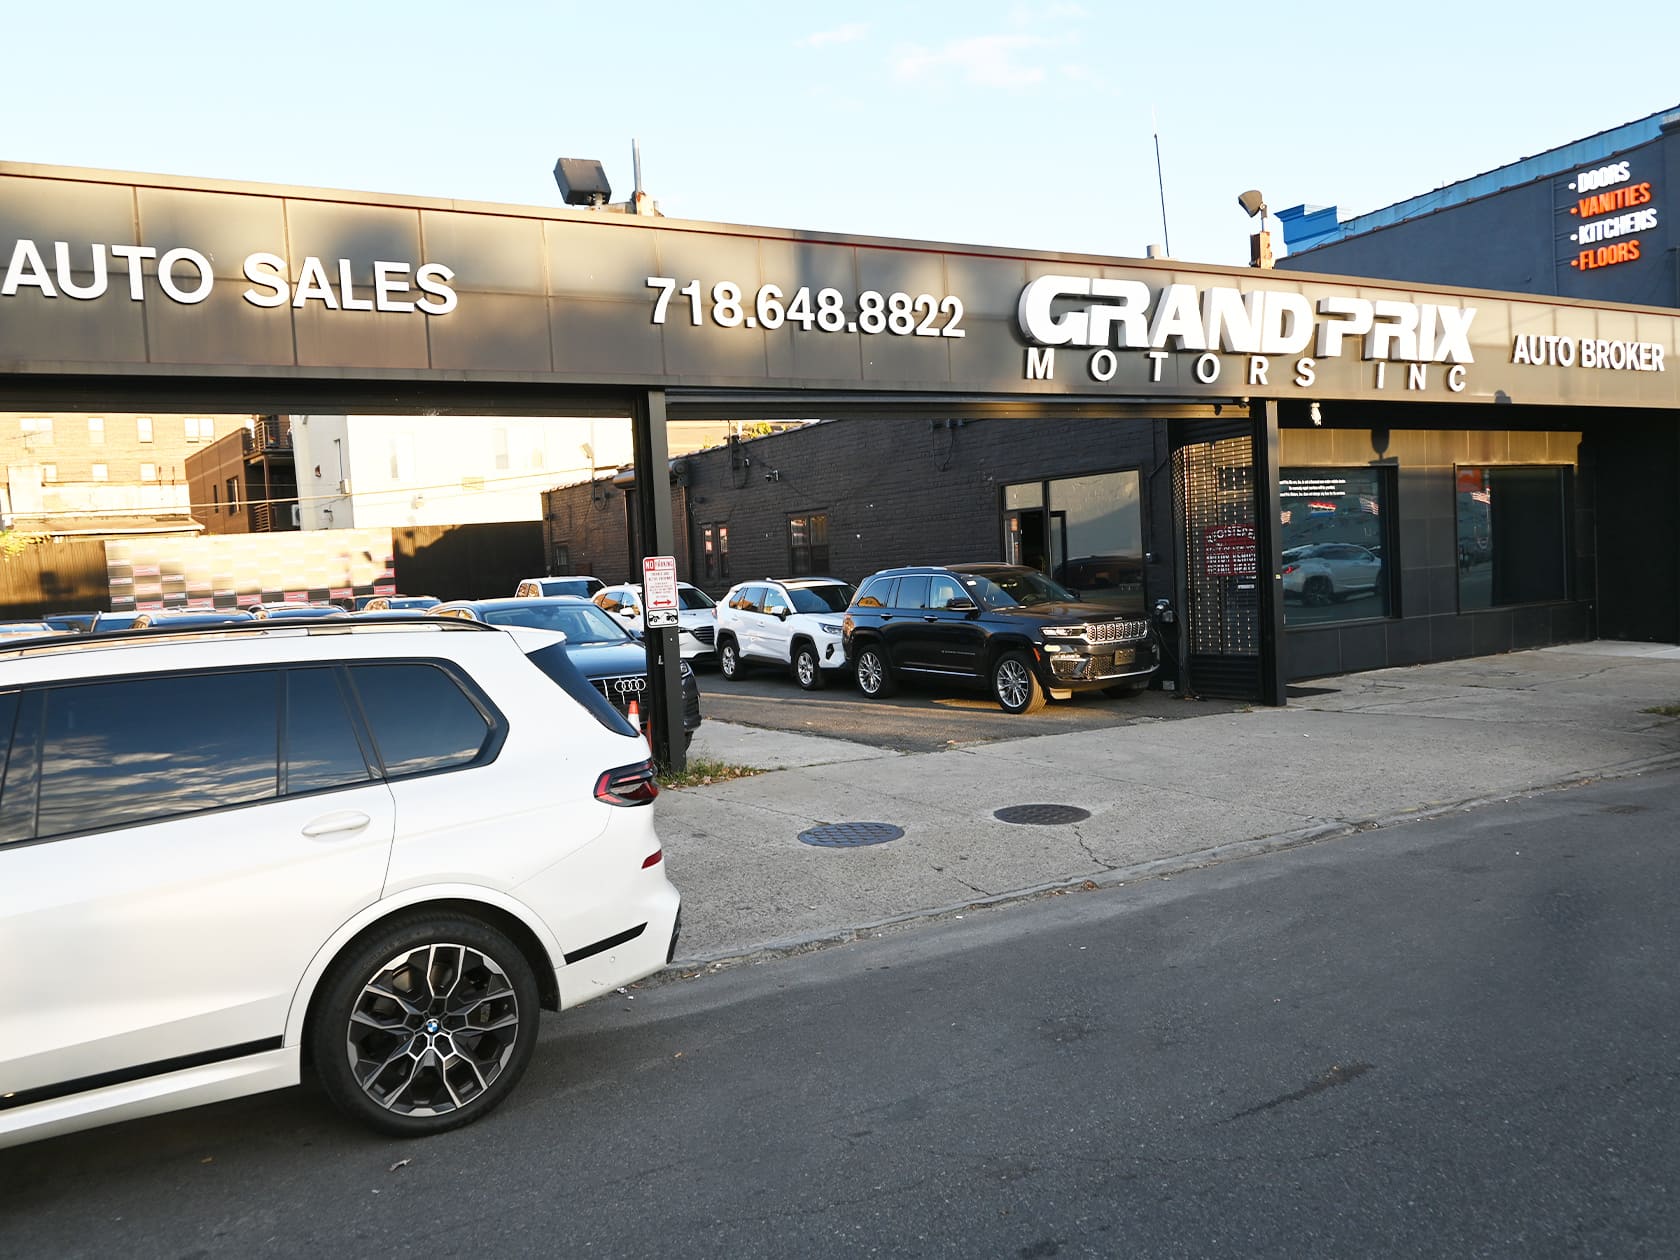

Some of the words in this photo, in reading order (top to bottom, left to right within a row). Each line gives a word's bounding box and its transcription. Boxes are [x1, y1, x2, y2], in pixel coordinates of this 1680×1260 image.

[1577, 161, 1631, 193] DOORS
[1578, 182, 1652, 218] VANITIES
[1579, 208, 1658, 244] KITCHENS
[1579, 239, 1641, 271] FLOORS
[1, 239, 214, 304] AUTO
[243, 252, 458, 315] SALES
[647, 276, 966, 338] 718.648.8822
[1017, 275, 1315, 355] GRAND
[1315, 296, 1478, 364] PRIX
[1025, 347, 1316, 387] MOTORS
[1375, 361, 1467, 392] INC
[1511, 333, 1576, 367] AUTO
[1579, 338, 1665, 372] BROKER
[645, 560, 655, 570] NO
